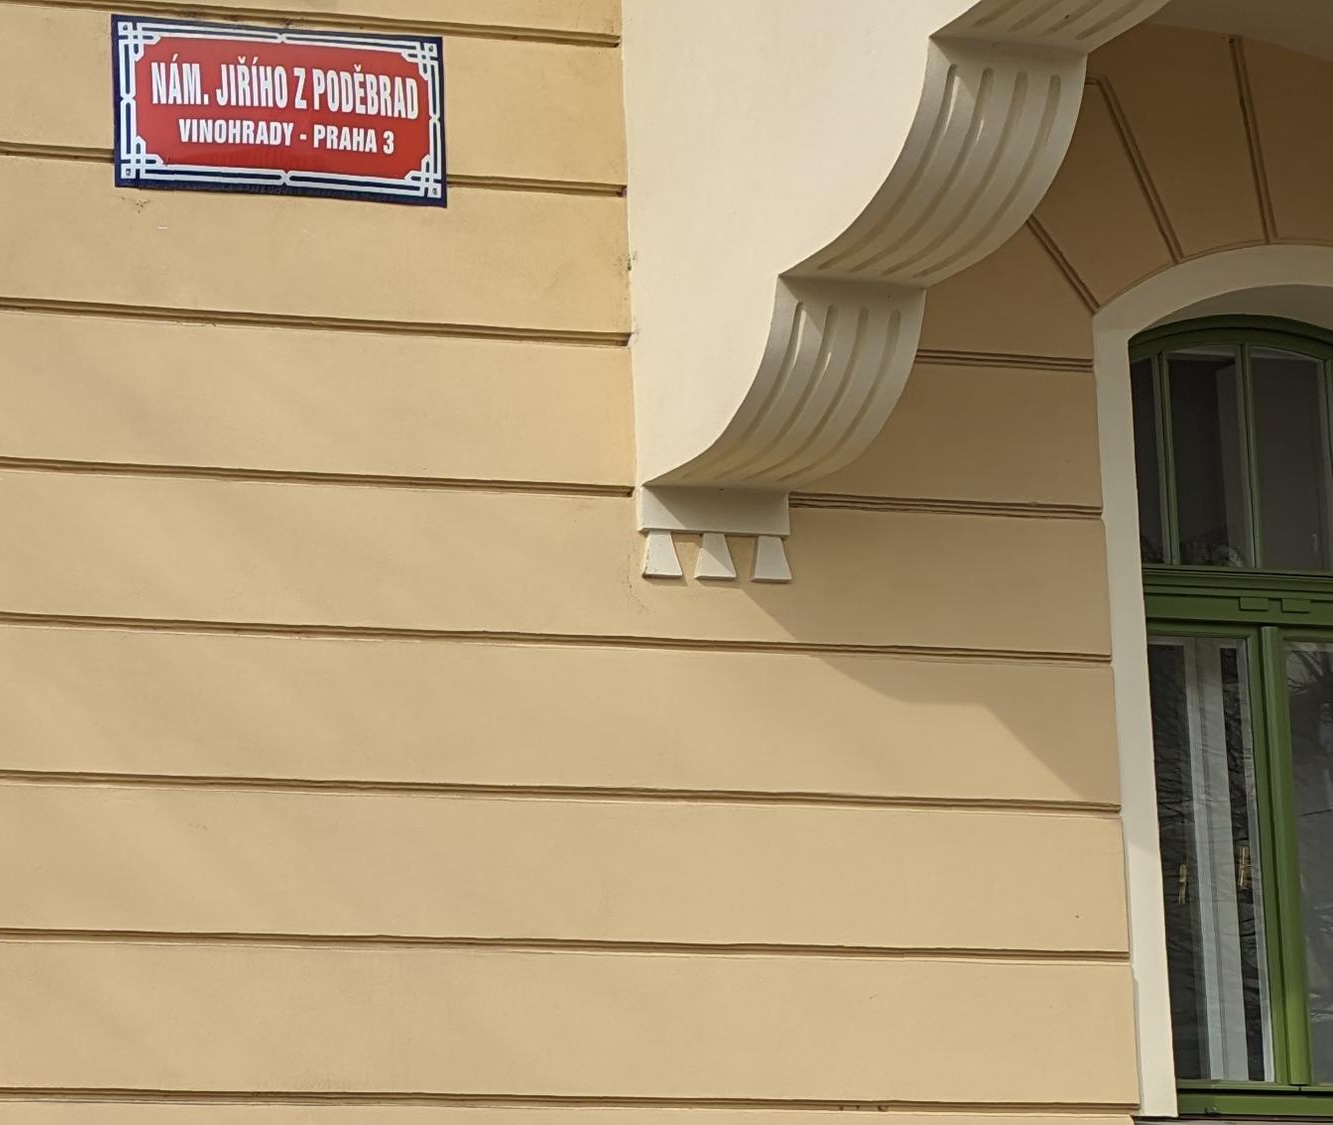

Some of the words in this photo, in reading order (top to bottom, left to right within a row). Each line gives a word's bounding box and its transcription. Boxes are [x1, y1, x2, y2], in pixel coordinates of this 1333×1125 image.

[151, 54, 209, 105] NÁM.
[216, 56, 287, 109] JIŘÍHO
[294, 68, 307, 109] Z
[313, 64, 419, 120] PODĚBRAD
[179, 118, 294, 147] VINOHRADY
[313, 125, 377, 154] PRAHA
[383, 131, 395, 155] 3
